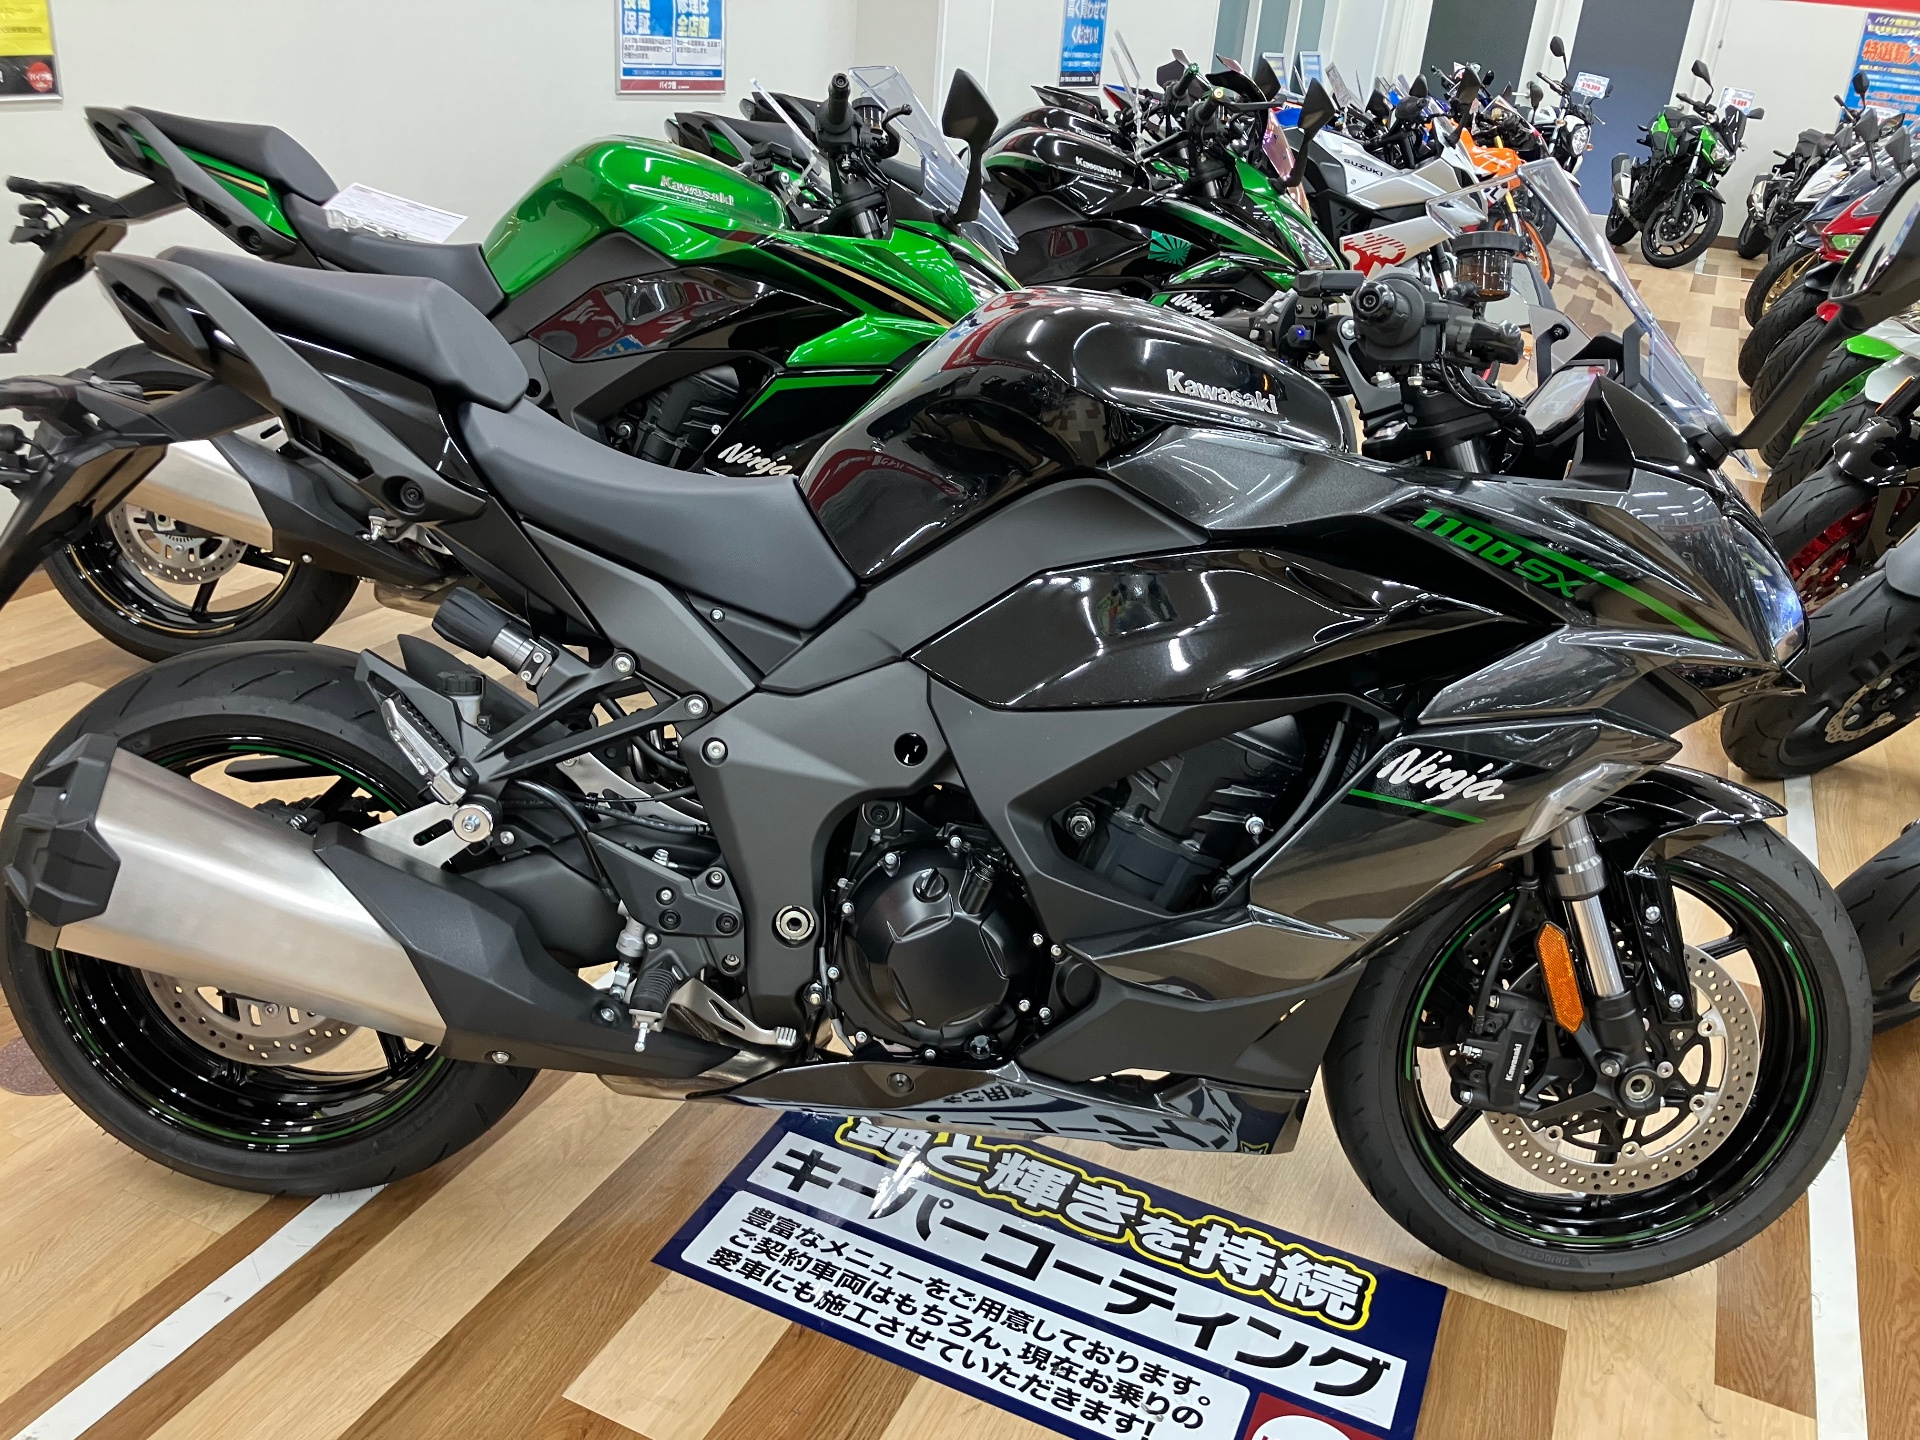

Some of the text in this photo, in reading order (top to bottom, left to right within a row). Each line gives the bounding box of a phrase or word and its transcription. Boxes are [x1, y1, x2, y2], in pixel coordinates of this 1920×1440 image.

[623, 10, 651, 35] 保証
[1075, 155, 1123, 179] Kawasaki
[1343, 158, 1384, 178] SUZUKI
[660, 174, 735, 207] Kawasaki
[1170, 292, 1217, 320] Ninja
[1166, 368, 1279, 415] Kawasaki
[717, 442, 793, 476] Ninja
[1376, 747, 1505, 804] Ninja
[1504, 1043, 1523, 1081] Kawasaki
[771, 1148, 1391, 1397] キーパーコーティング
[741, 1205, 1211, 1406] 豊富なメニューをご用意しております。
[728, 1227, 1204, 1429] ご契約車両はもちろん、現在お乗りの
